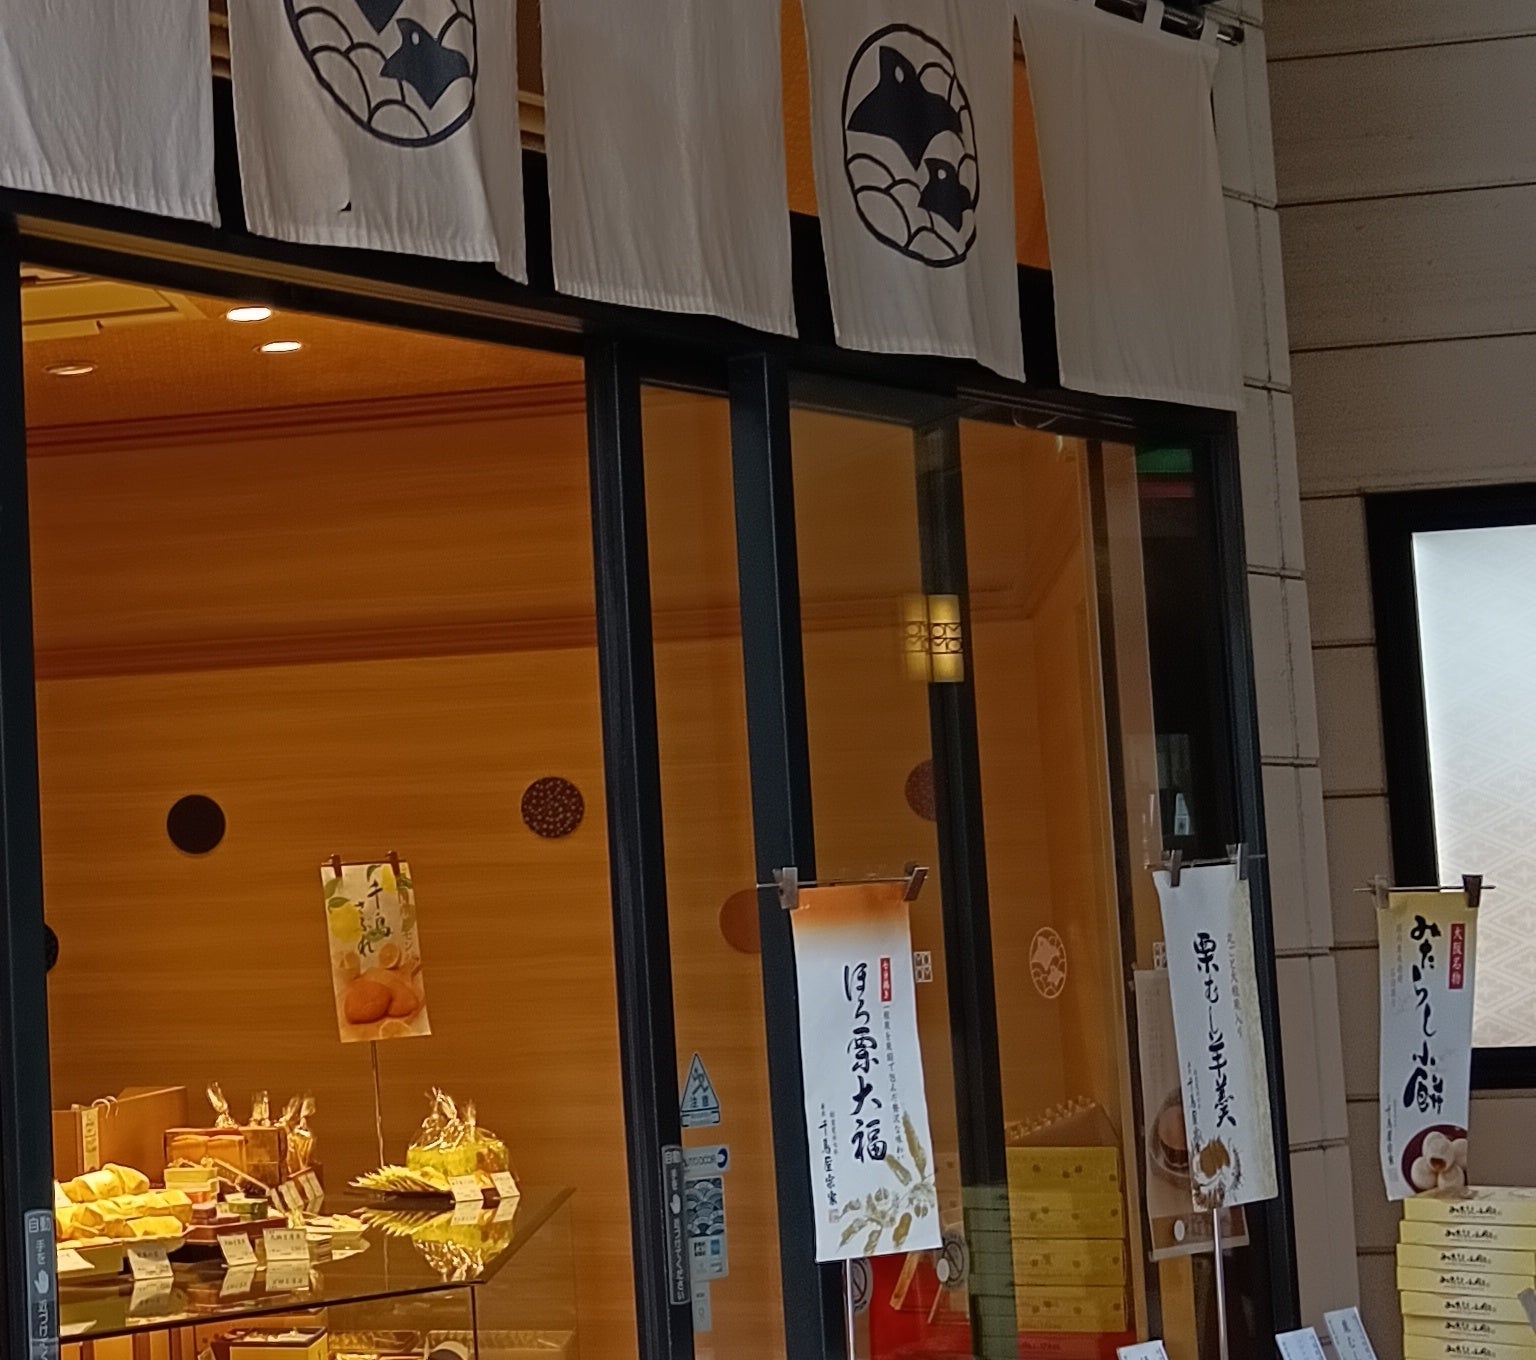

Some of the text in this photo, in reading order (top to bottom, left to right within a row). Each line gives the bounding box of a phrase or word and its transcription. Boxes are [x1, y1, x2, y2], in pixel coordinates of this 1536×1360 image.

[843, 962, 888, 1164] ほろ栗大福
[28, 1217, 52, 1234] 自動
